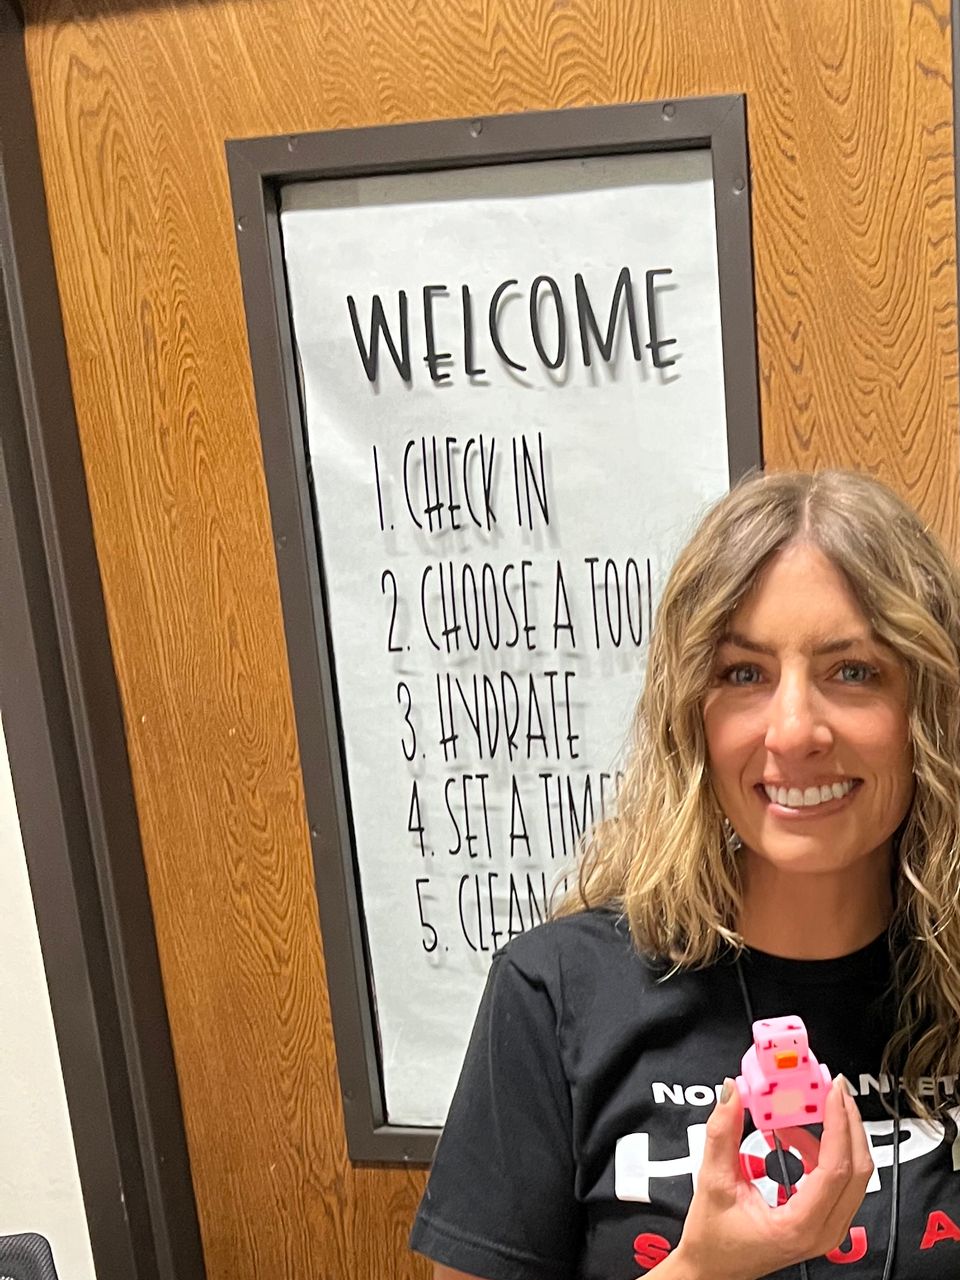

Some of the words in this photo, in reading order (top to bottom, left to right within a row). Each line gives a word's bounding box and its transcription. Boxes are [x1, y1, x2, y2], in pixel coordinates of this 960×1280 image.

[347, 267, 677, 382] WELCOME
[374, 445, 394, 532] 1.
[404, 434, 497, 532] CHECK
[513, 433, 549, 531] IN
[381, 570, 410, 652] 2.
[421, 561, 537, 652] CHOOSE
[554, 561, 575, 649] A
[397, 682, 426, 761] 3.
[436, 671, 580, 762] HYDRATE
[408, 781, 435, 858] 4.
[445, 774, 491, 859] SET
[509, 774, 531, 858] A
[539, 771, 625, 859] TIME
[416, 878, 449, 952] 5.
